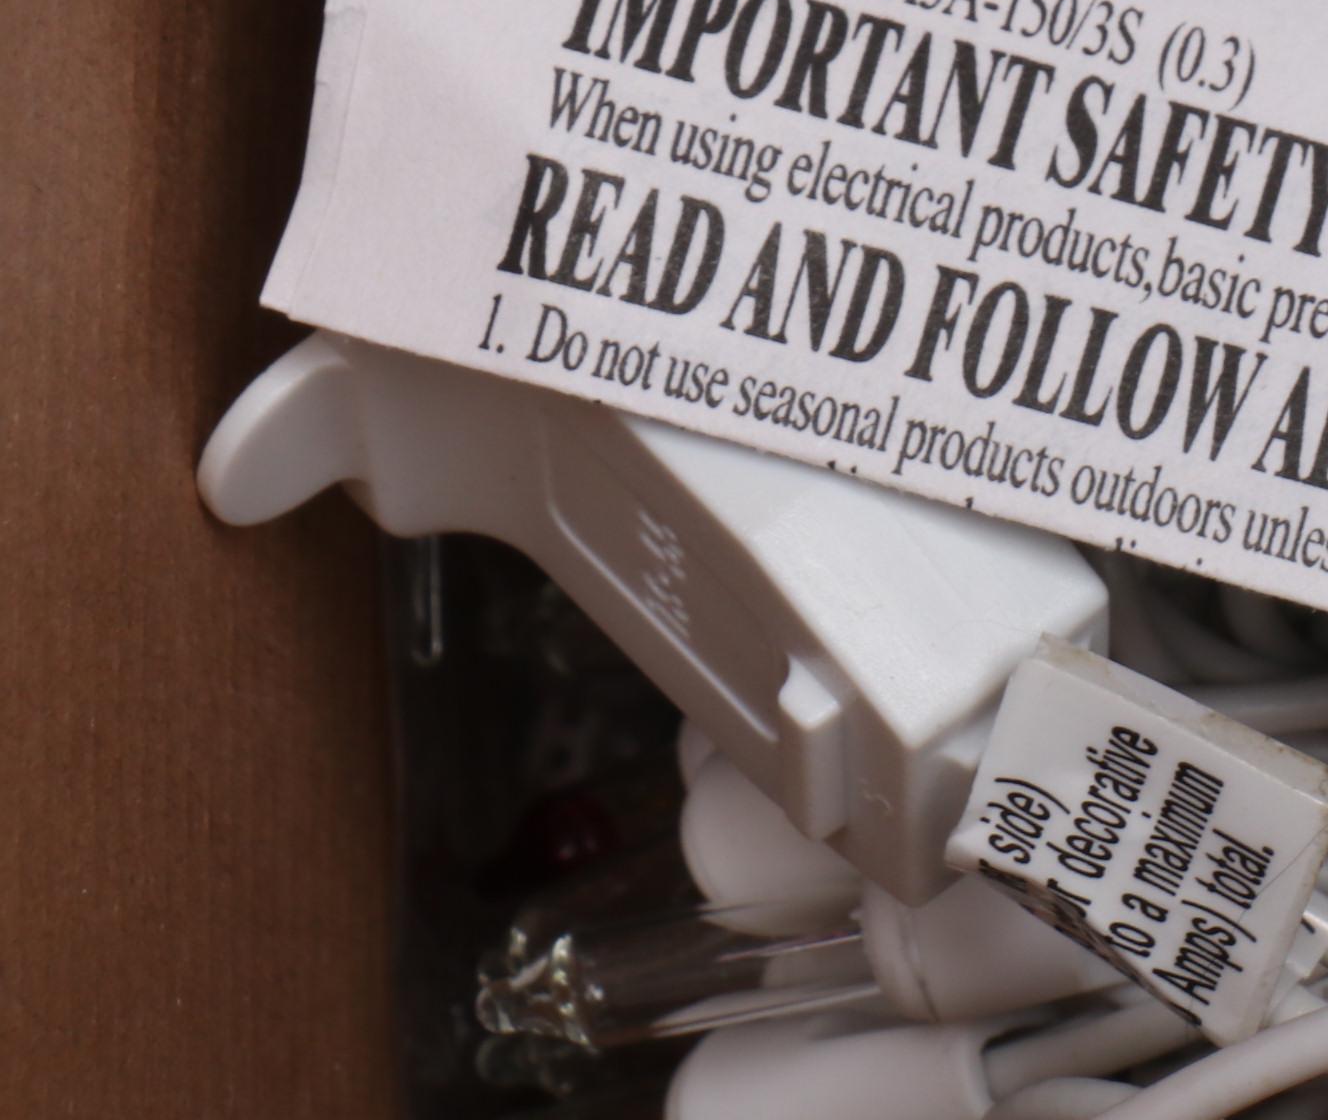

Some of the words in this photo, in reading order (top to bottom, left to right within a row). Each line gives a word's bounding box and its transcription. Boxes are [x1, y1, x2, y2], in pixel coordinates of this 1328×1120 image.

[1158, 27, 1255, 106] (0.3)
[550, 67, 662, 156] When
[670, 114, 783, 204] using
[787, 140, 975, 239] electrical
[496, 153, 726, 316] READ
[719, 222, 906, 364] AND
[903, 264, 1269, 462] FOLLOW
[478, 293, 505, 354] 1.
[525, 303, 589, 372] Do
[591, 339, 661, 391] not
[663, 356, 729, 409] use
[732, 376, 900, 452] seasonal
[891, 419, 1065, 498] products
[1070, 465, 1236, 544] outdoors
[978, 776, 1072, 866] side)
[1044, 725, 1160, 880] decorative
[1131, 760, 1225, 898] maximum
[1120, 892, 1171, 925] a
[1193, 827, 1276, 912] total.
[1103, 921, 1156, 959] to
[1151, 898, 1259, 1007] Amps)
